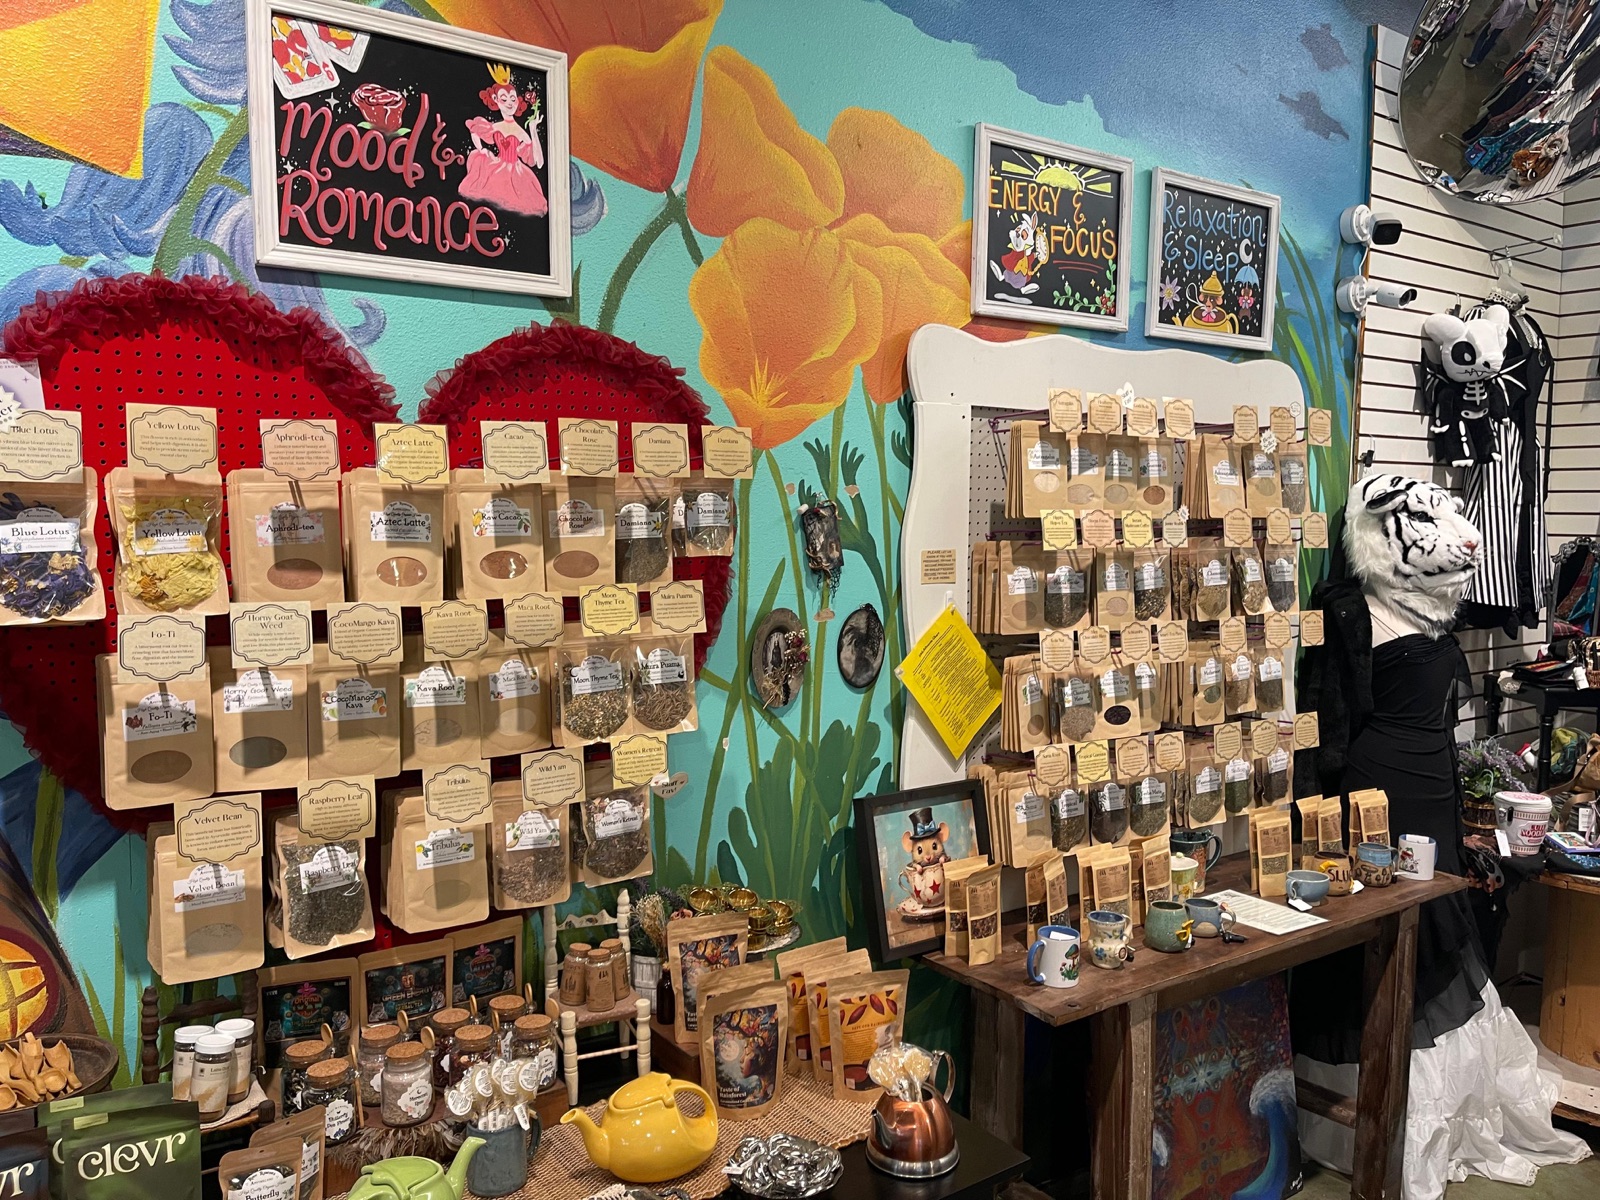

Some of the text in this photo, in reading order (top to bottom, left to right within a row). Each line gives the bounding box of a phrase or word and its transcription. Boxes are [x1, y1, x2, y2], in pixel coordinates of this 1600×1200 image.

[279, 93, 464, 188] Mood &
[988, 176, 1086, 229] ENERGY &
[277, 170, 505, 257] Romance
[1163, 189, 1266, 248] Relaxation
[1050, 225, 1116, 259] FOCUS
[1163, 226, 1239, 284] & Sleep
[34, 426, 59, 435] Lotus
[147, 421, 201, 431] Yellow Lotus
[574, 426, 604, 435] Chocolate
[413, 439, 434, 447] Latte
[697, 507, 725, 515] Damiana
[377, 517, 426, 527] Aztec Latte
[481, 513, 522, 521] Raw Cacao
[620, 519, 652, 527] Damiana
[11, 526, 70, 537] Blue Lotus
[142, 528, 201, 538] Yellow Lotus
[266, 523, 315, 534] Aphrodi-tea
[248, 613, 293, 622] Horny Goat
[454, 610, 471, 618] Root
[260, 621, 283, 630] Weed
[333, 620, 376, 629] CocoMango
[590, 674, 609, 683] Thyme
[224, 688, 248, 696] Horny
[148, 711, 173, 721] Fo-Ti
[538, 764, 553, 773] Wild
[446, 778, 471, 787] Tribulus
[309, 792, 365, 805] Raspberry Leaf
[194, 813, 243, 825] Velvet Bean
[430, 841, 461, 851] Tribulus
[304, 859, 357, 878] Raspberry Leaf
[188, 880, 235, 894] Velvet Bean
[78, 1131, 187, 1181] clevr
